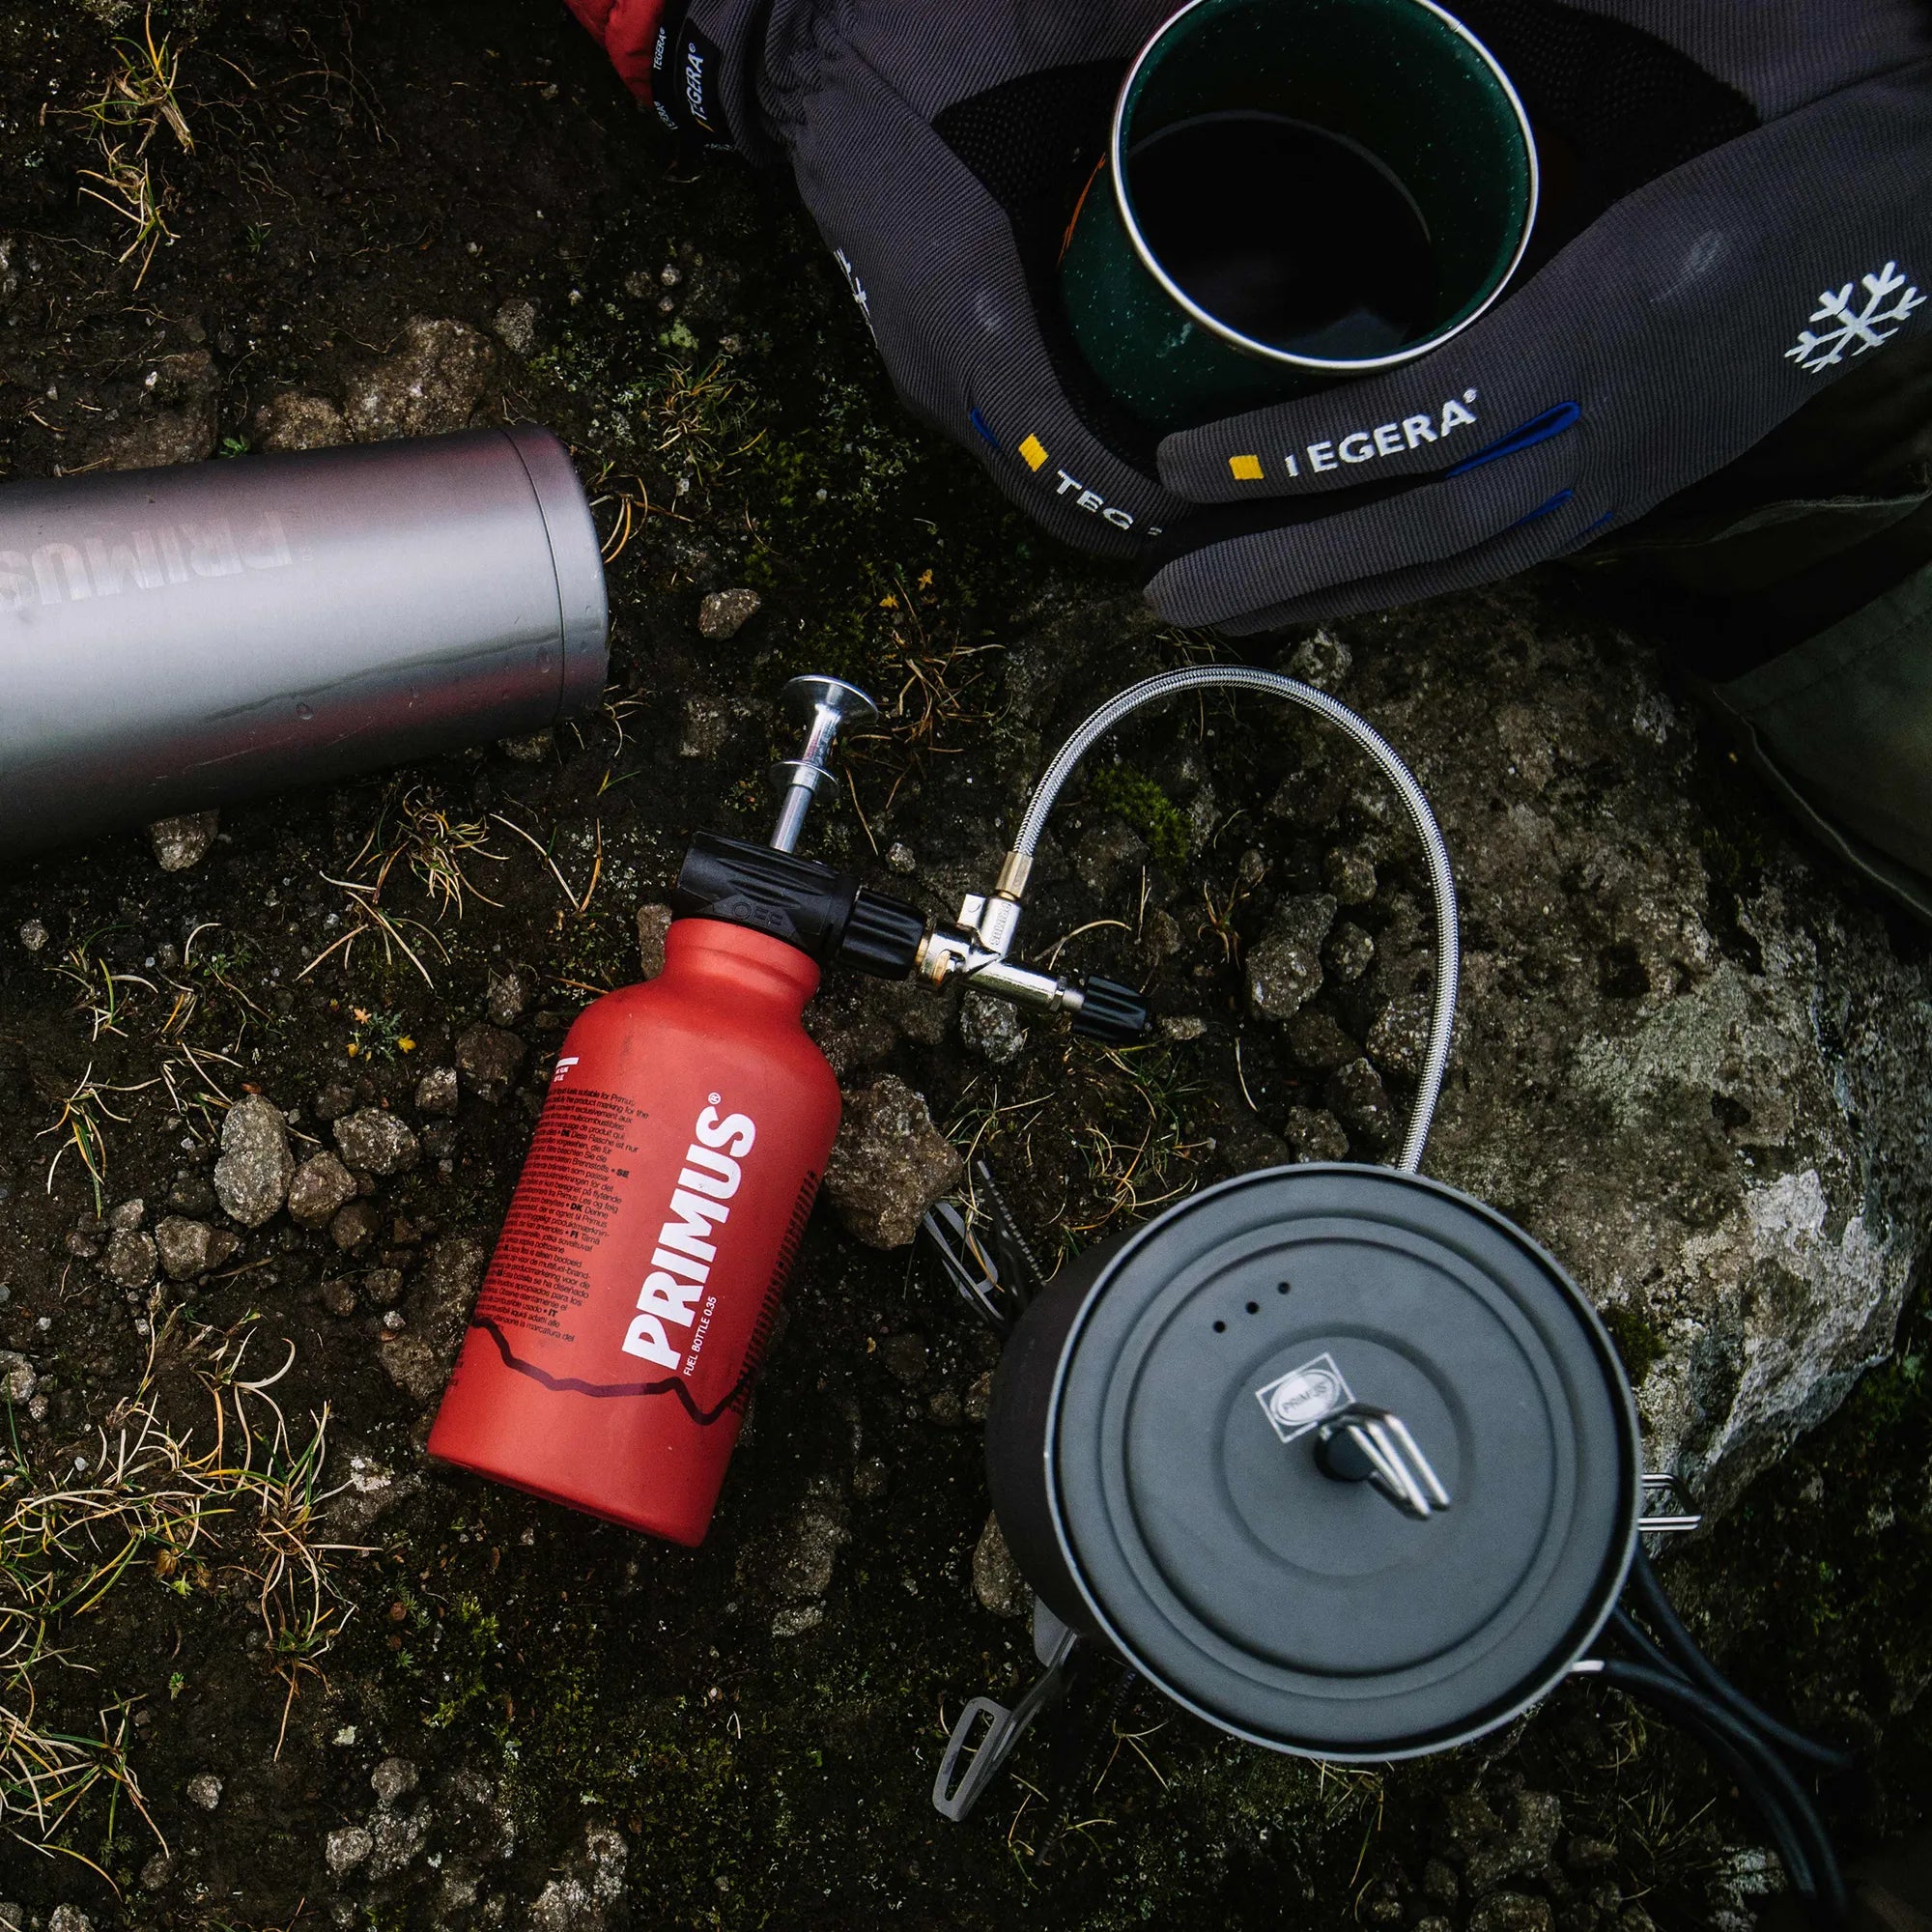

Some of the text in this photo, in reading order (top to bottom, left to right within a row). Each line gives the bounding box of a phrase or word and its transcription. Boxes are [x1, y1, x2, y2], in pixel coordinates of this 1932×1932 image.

[686, 43, 707, 120] TGERA®
[988, 901, 1012, 948] PRIMUS
[596, 1101, 623, 1113] marking
[636, 1109, 649, 1118] the
[588, 1134, 614, 1145] Flasche
[584, 1151, 595, 1159] Sie
[615, 1168, 629, 1178] SE
[570, 1202, 583, 1211] DK
[584, 1206, 608, 1219] Denne
[582, 1215, 607, 1227] Primus
[562, 1277, 577, 1285] voor
[550, 1292, 568, 1301] para
[570, 1296, 582, 1306] los
[561, 1333, 575, 1342] del
[683, 1296, 717, 1377] FUEL BOTTLE 0.35
